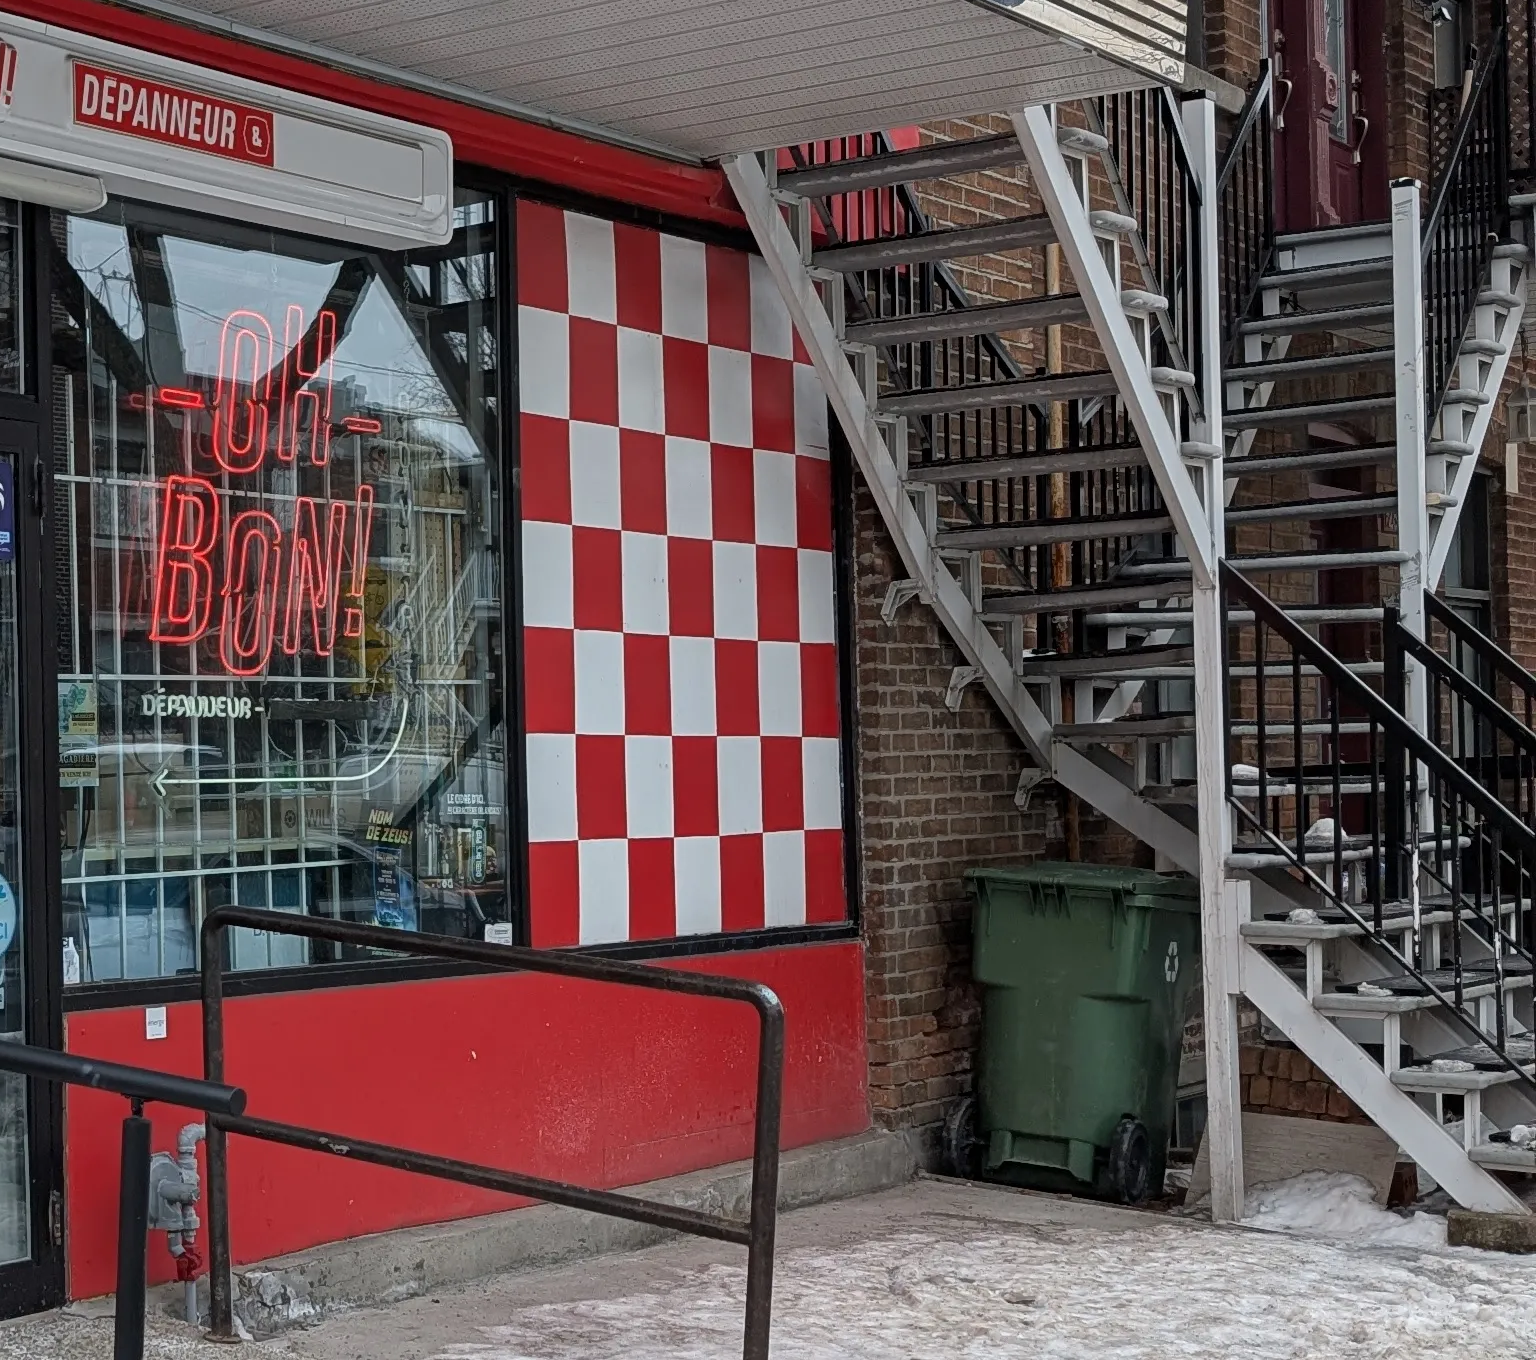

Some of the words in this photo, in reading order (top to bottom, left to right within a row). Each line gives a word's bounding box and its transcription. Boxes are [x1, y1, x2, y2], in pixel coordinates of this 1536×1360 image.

[81, 73, 237, 150] DÉPANNEUR
[149, 474, 375, 676] BON!
[365, 825, 380, 840] DE
[381, 827, 413, 845] ZEUS!
[368, 808, 394, 826] NOM
